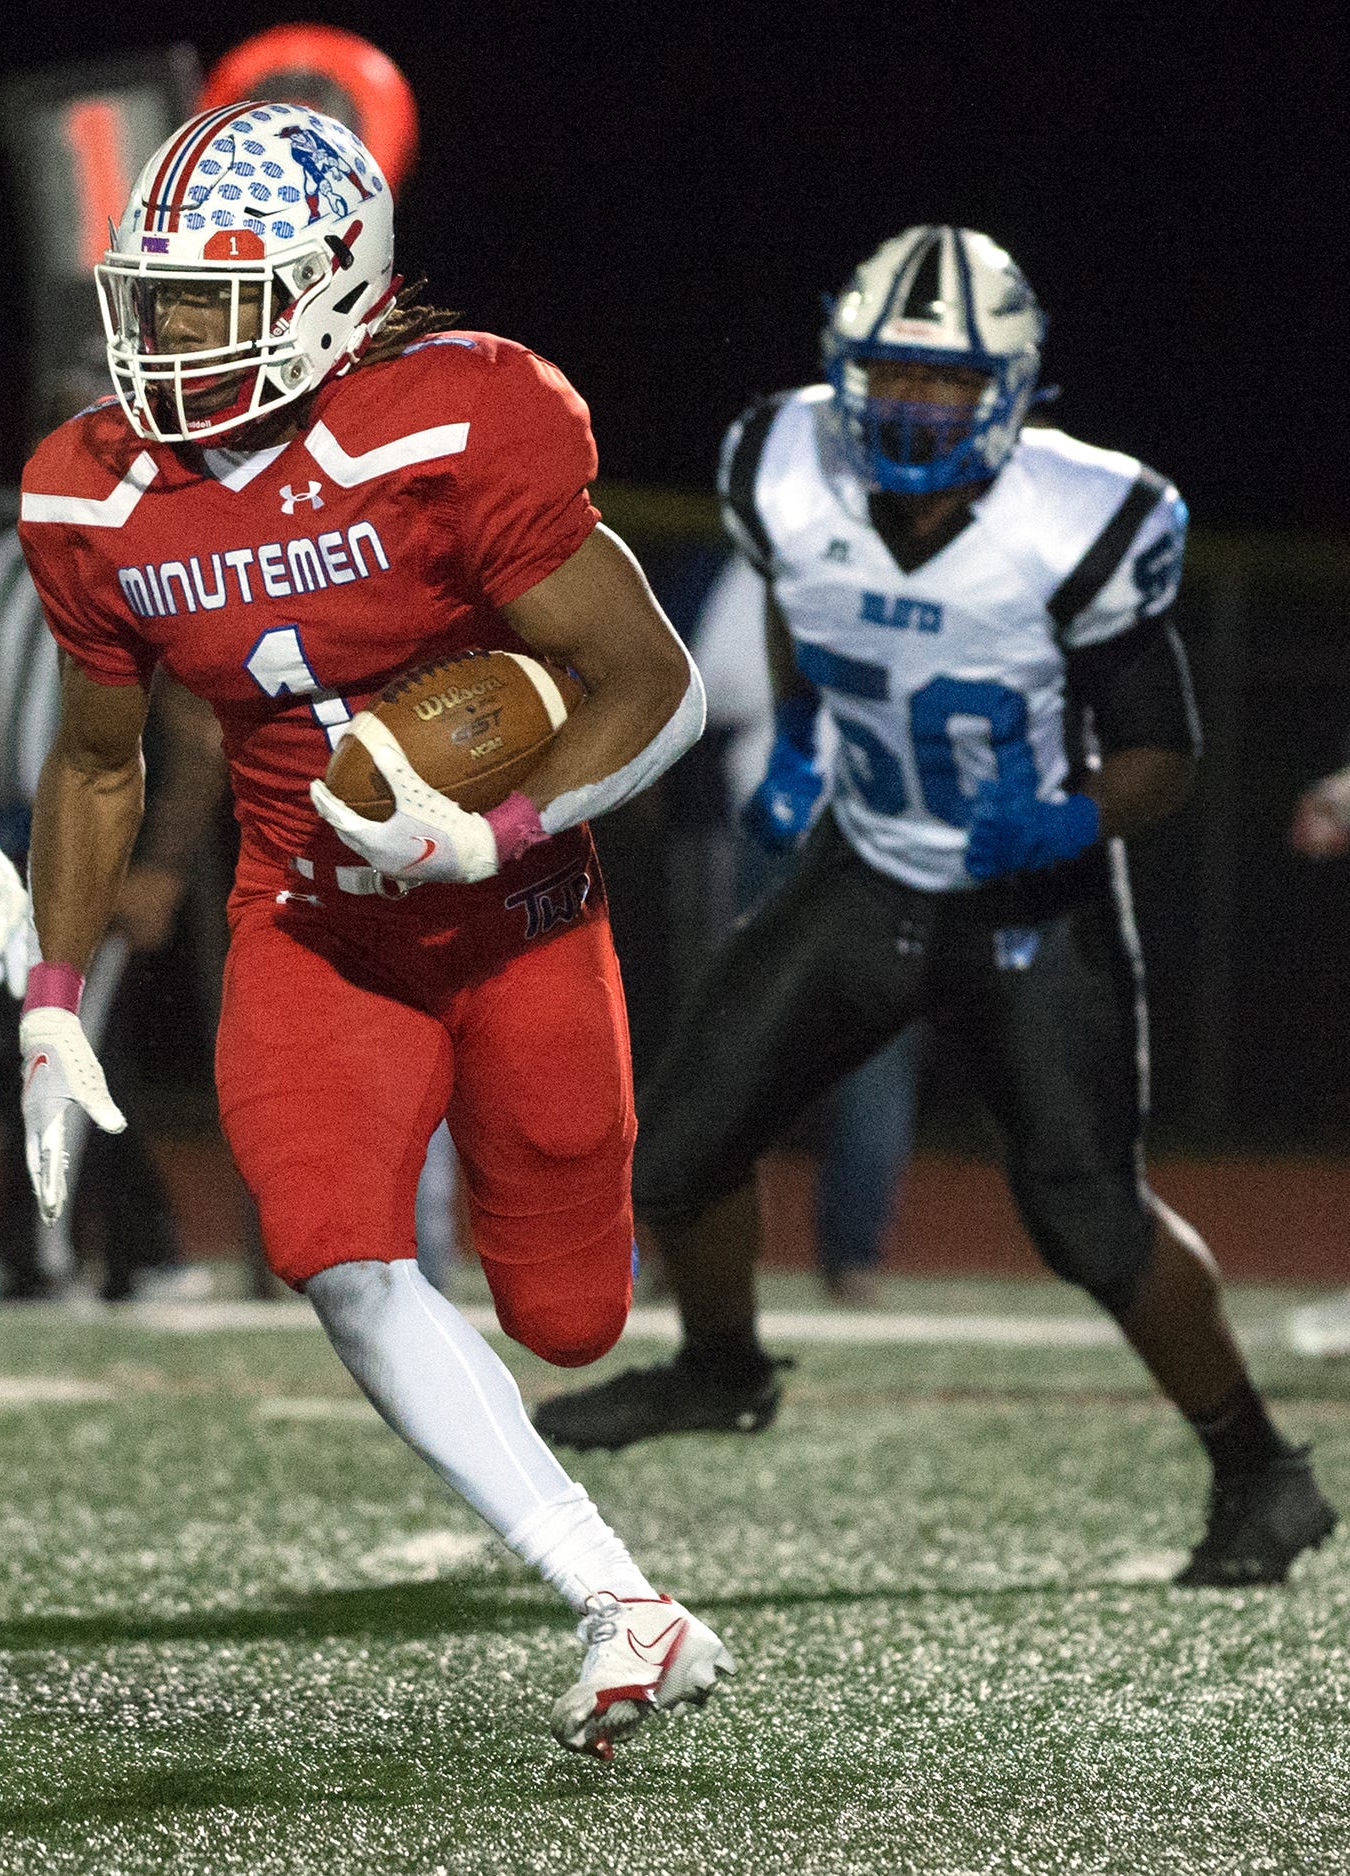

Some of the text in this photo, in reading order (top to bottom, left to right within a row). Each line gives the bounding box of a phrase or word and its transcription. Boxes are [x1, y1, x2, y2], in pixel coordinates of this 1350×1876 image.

[198, 159, 223, 175] PRIDE
[259, 160, 285, 179] PRIDE
[217, 183, 243, 201] PRIDE
[247, 182, 272, 202] PRIDE
[277, 185, 301, 203] PRIDE
[271, 220, 295, 239] PRIDE
[229, 236, 239, 255] 1
[117, 519, 391, 618] MINUTEMEN
[242, 624, 354, 753] 1
[412, 676, 506, 721] Wilson
[796, 640, 1038, 829] 50
